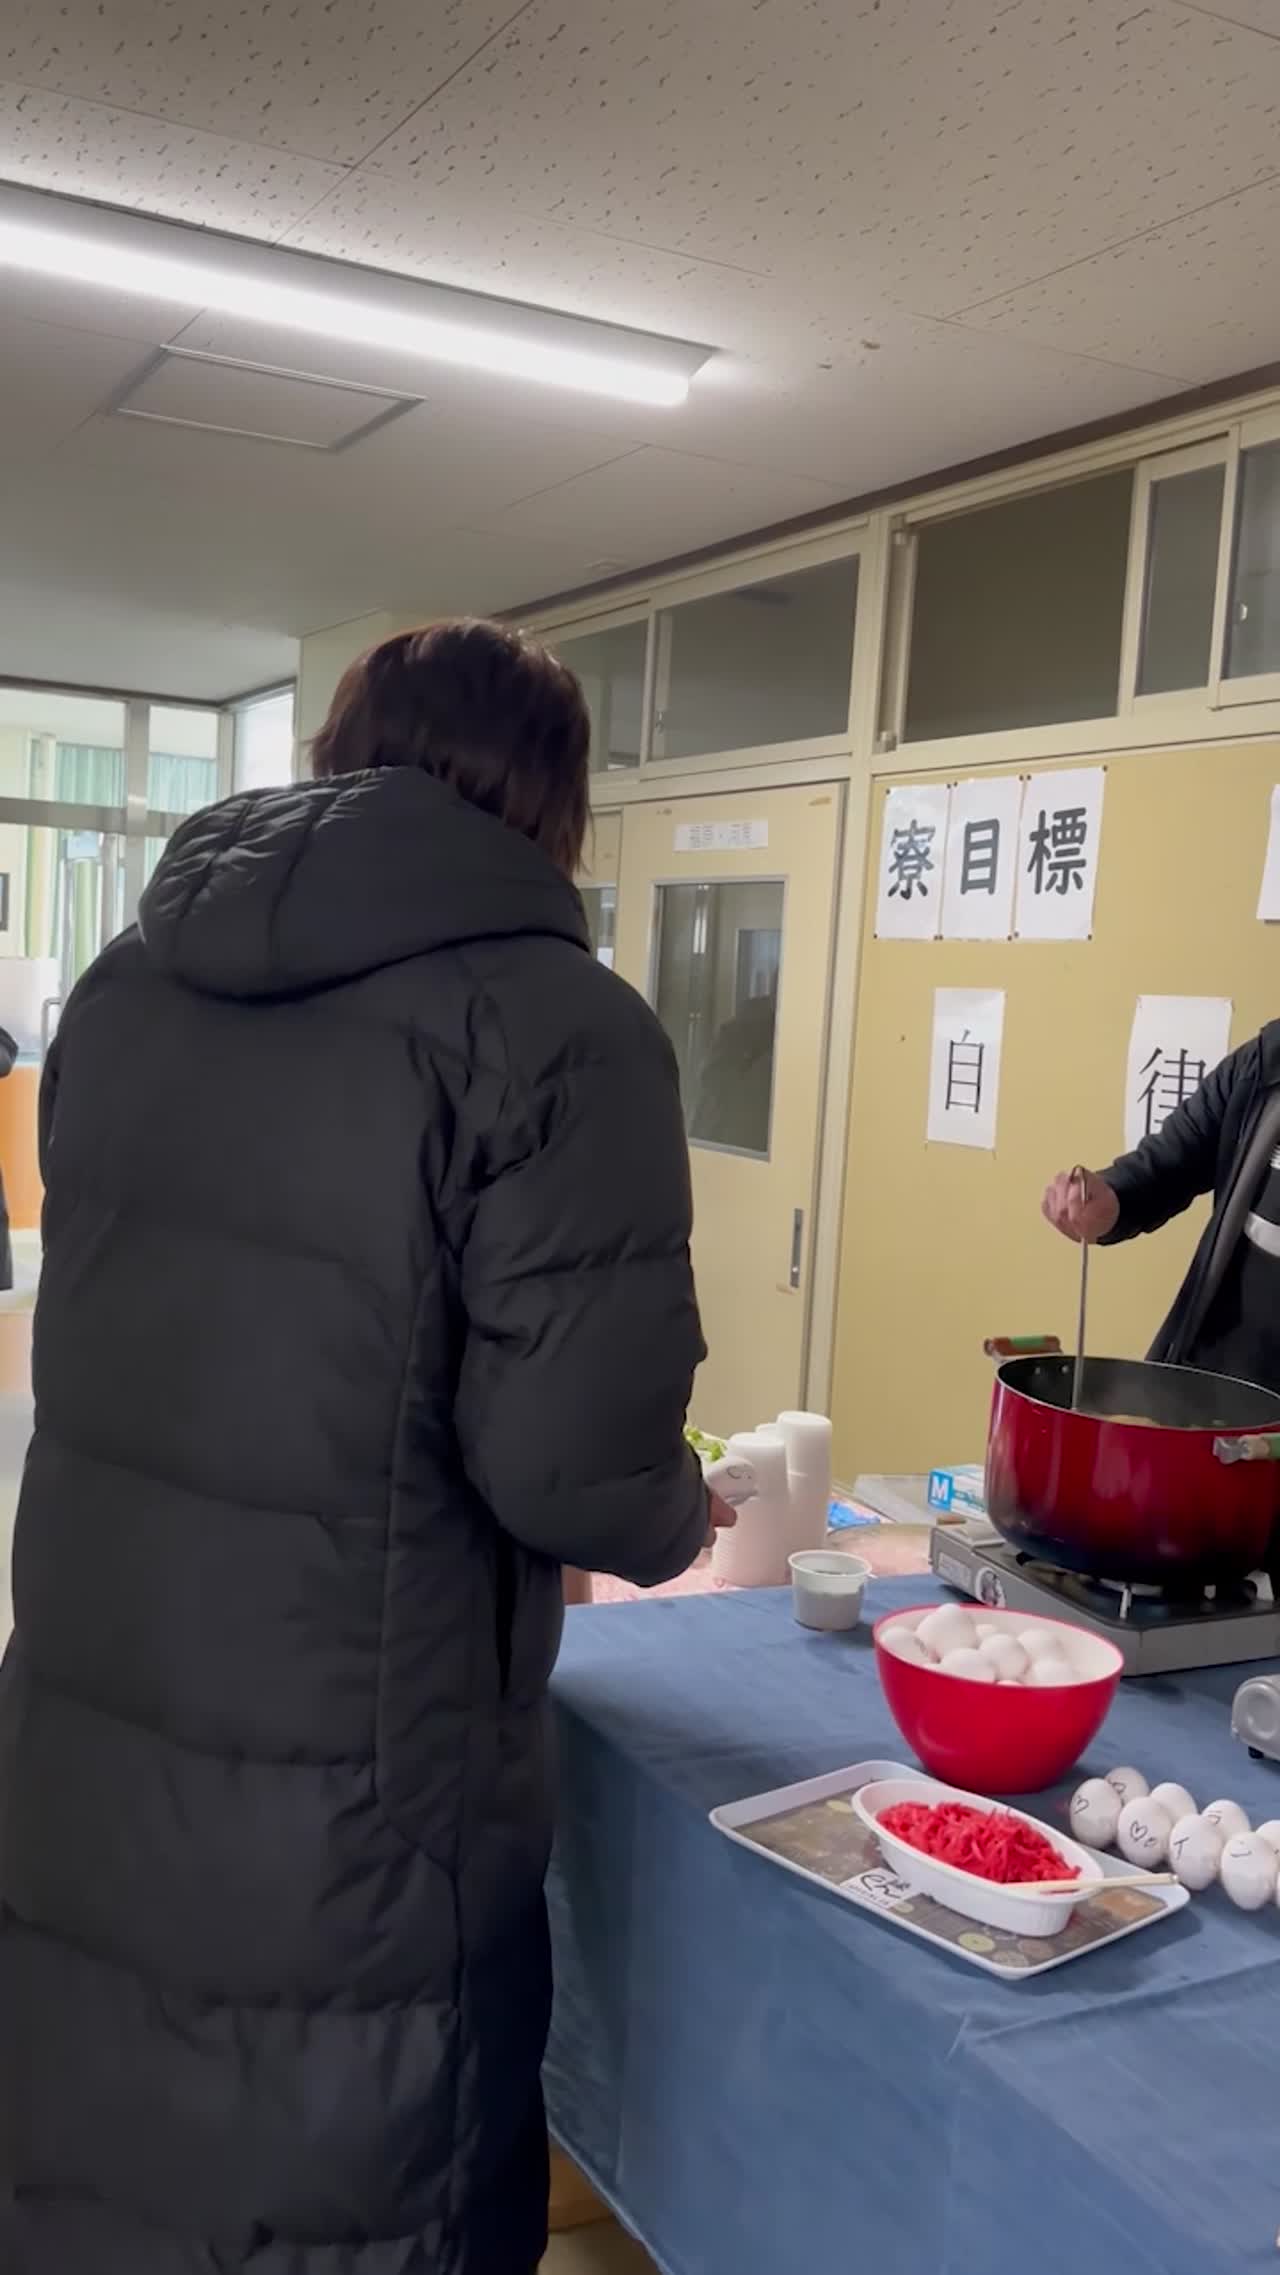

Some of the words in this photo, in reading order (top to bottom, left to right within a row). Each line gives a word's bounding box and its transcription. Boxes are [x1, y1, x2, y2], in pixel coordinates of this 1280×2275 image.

[887, 806, 1088, 900] 寮目標
[945, 1029, 985, 1113] 自
[931, 1474, 950, 1502] M
